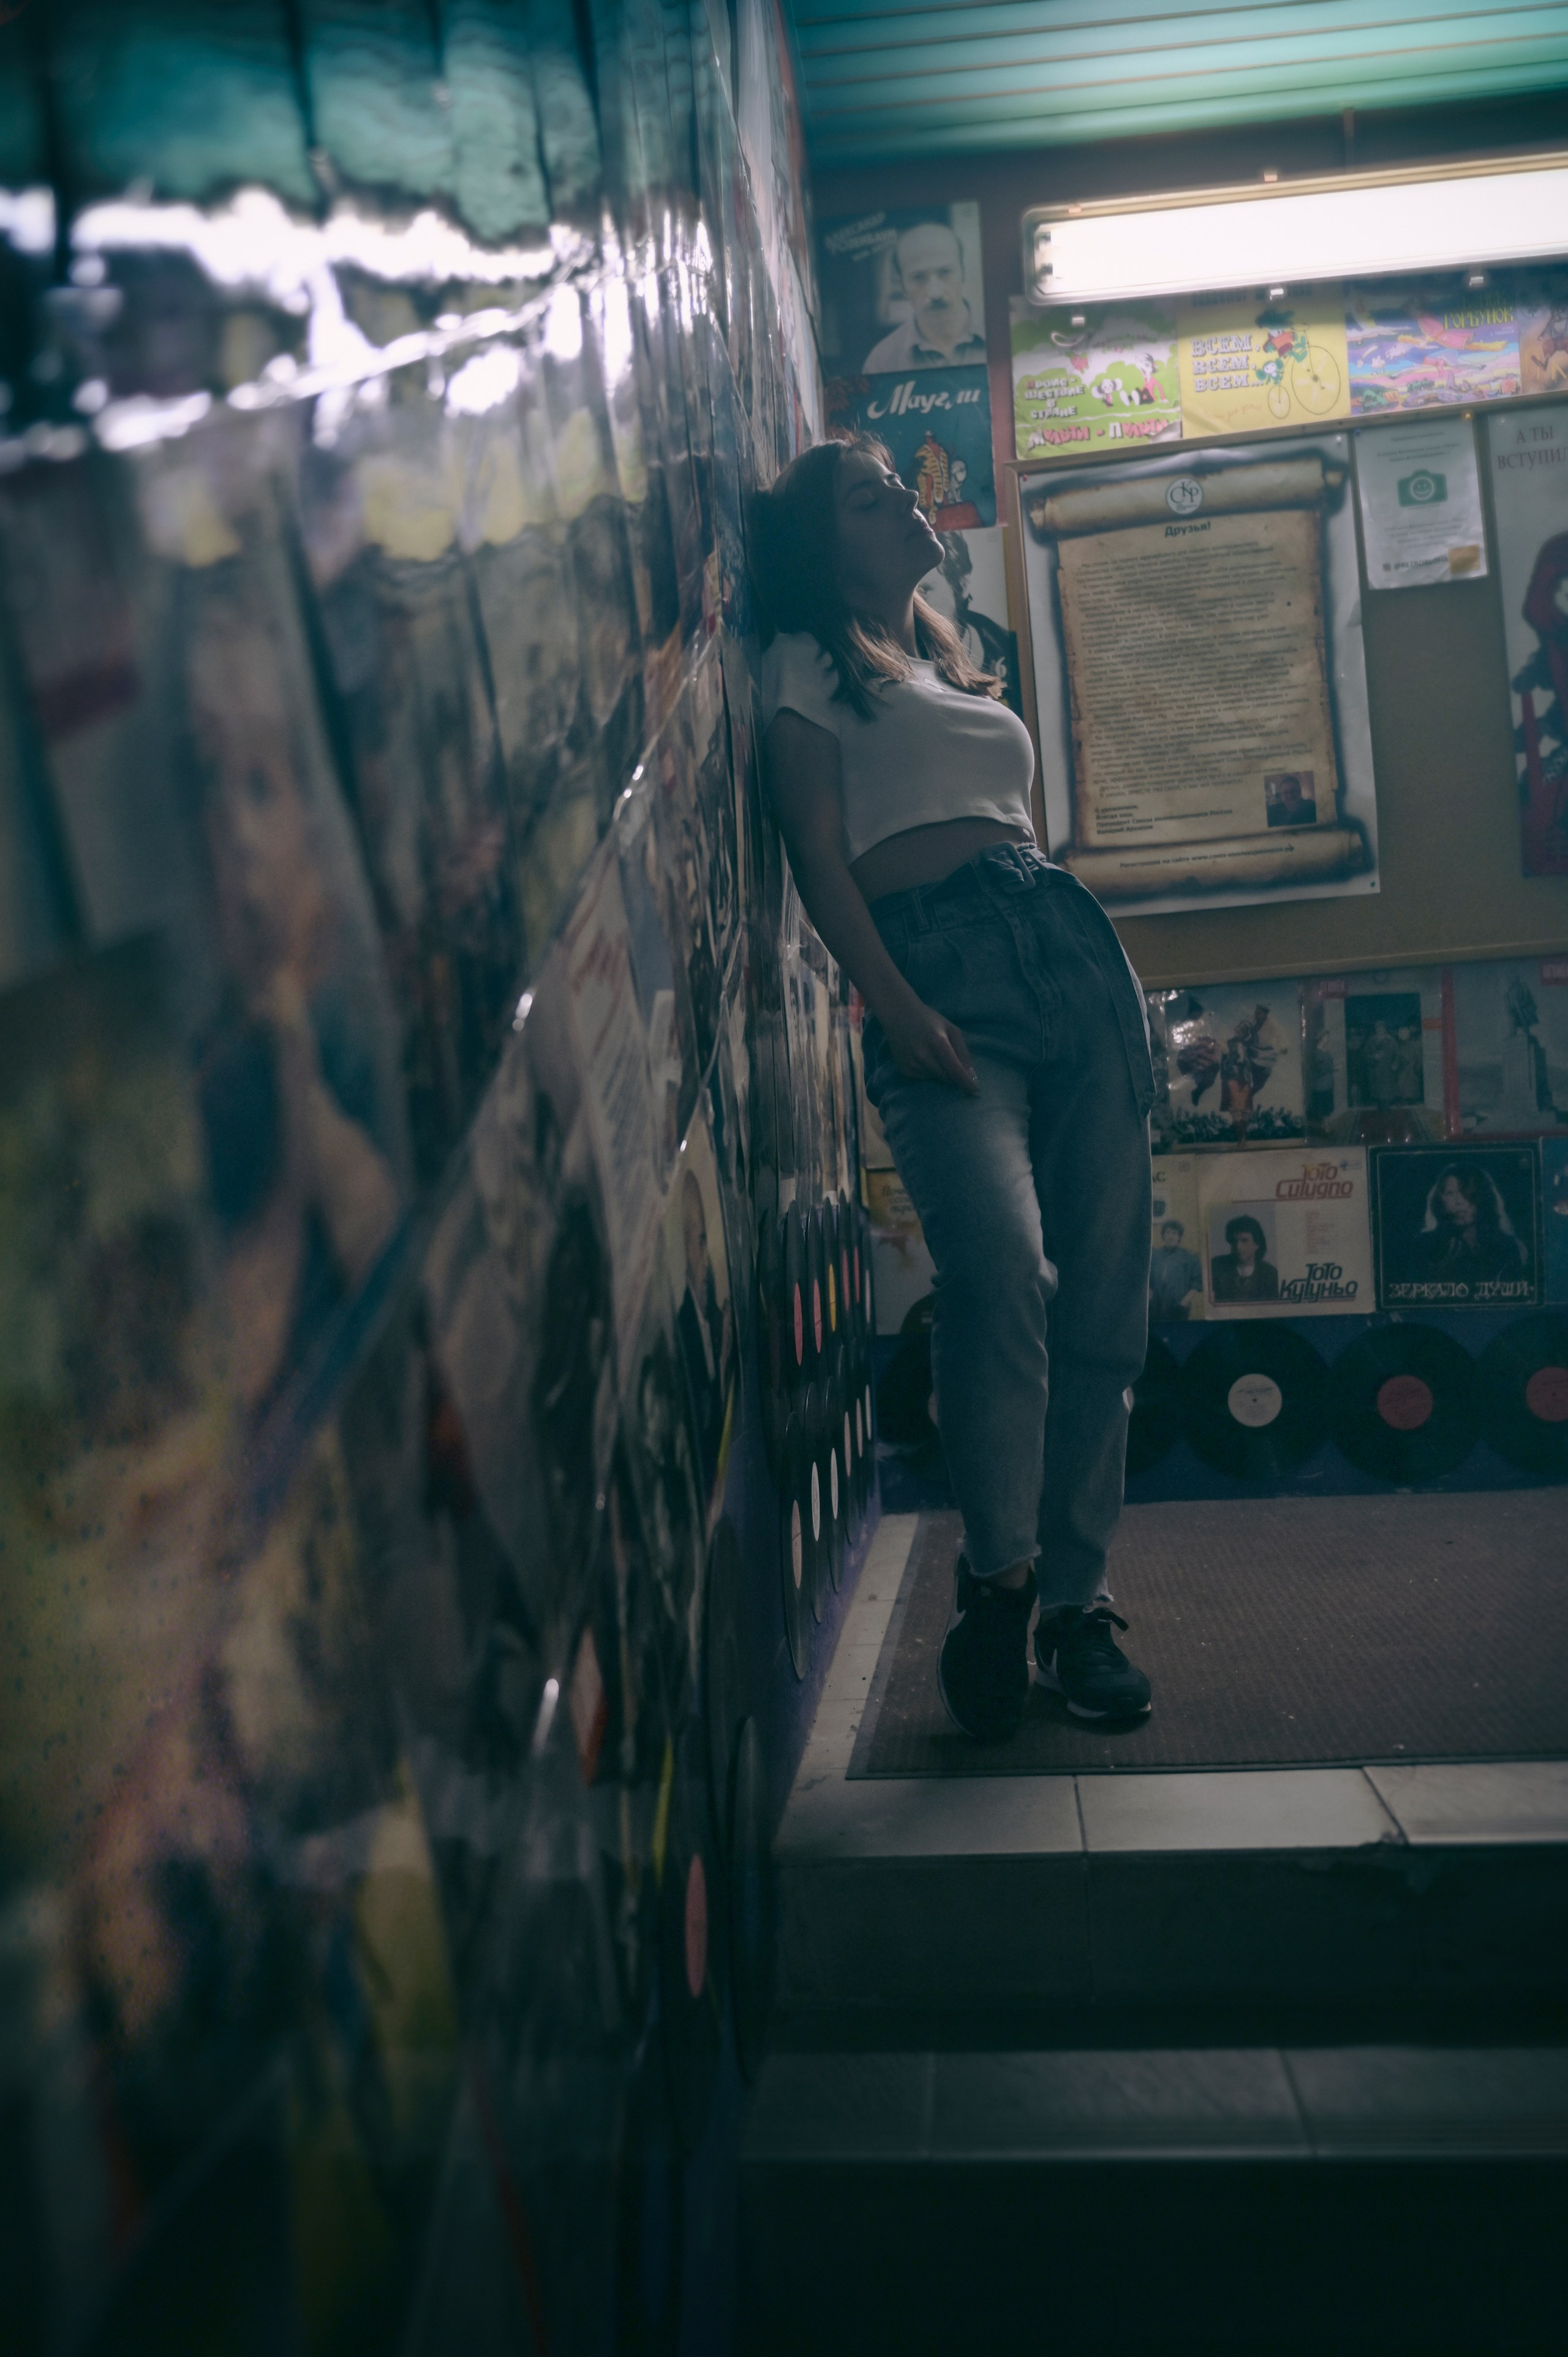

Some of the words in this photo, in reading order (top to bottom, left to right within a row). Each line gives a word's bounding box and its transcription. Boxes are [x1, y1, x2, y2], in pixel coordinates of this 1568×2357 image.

[1024, 385, 1085, 400] ШЕСТВИЕ
[1515, 428, 1527, 444] А
[1529, 424, 1555, 441] ТЫ
[1165, 521, 1211, 538] Друзья!
[1388, 1281, 1469, 1299] ЗЕРКАЛО
